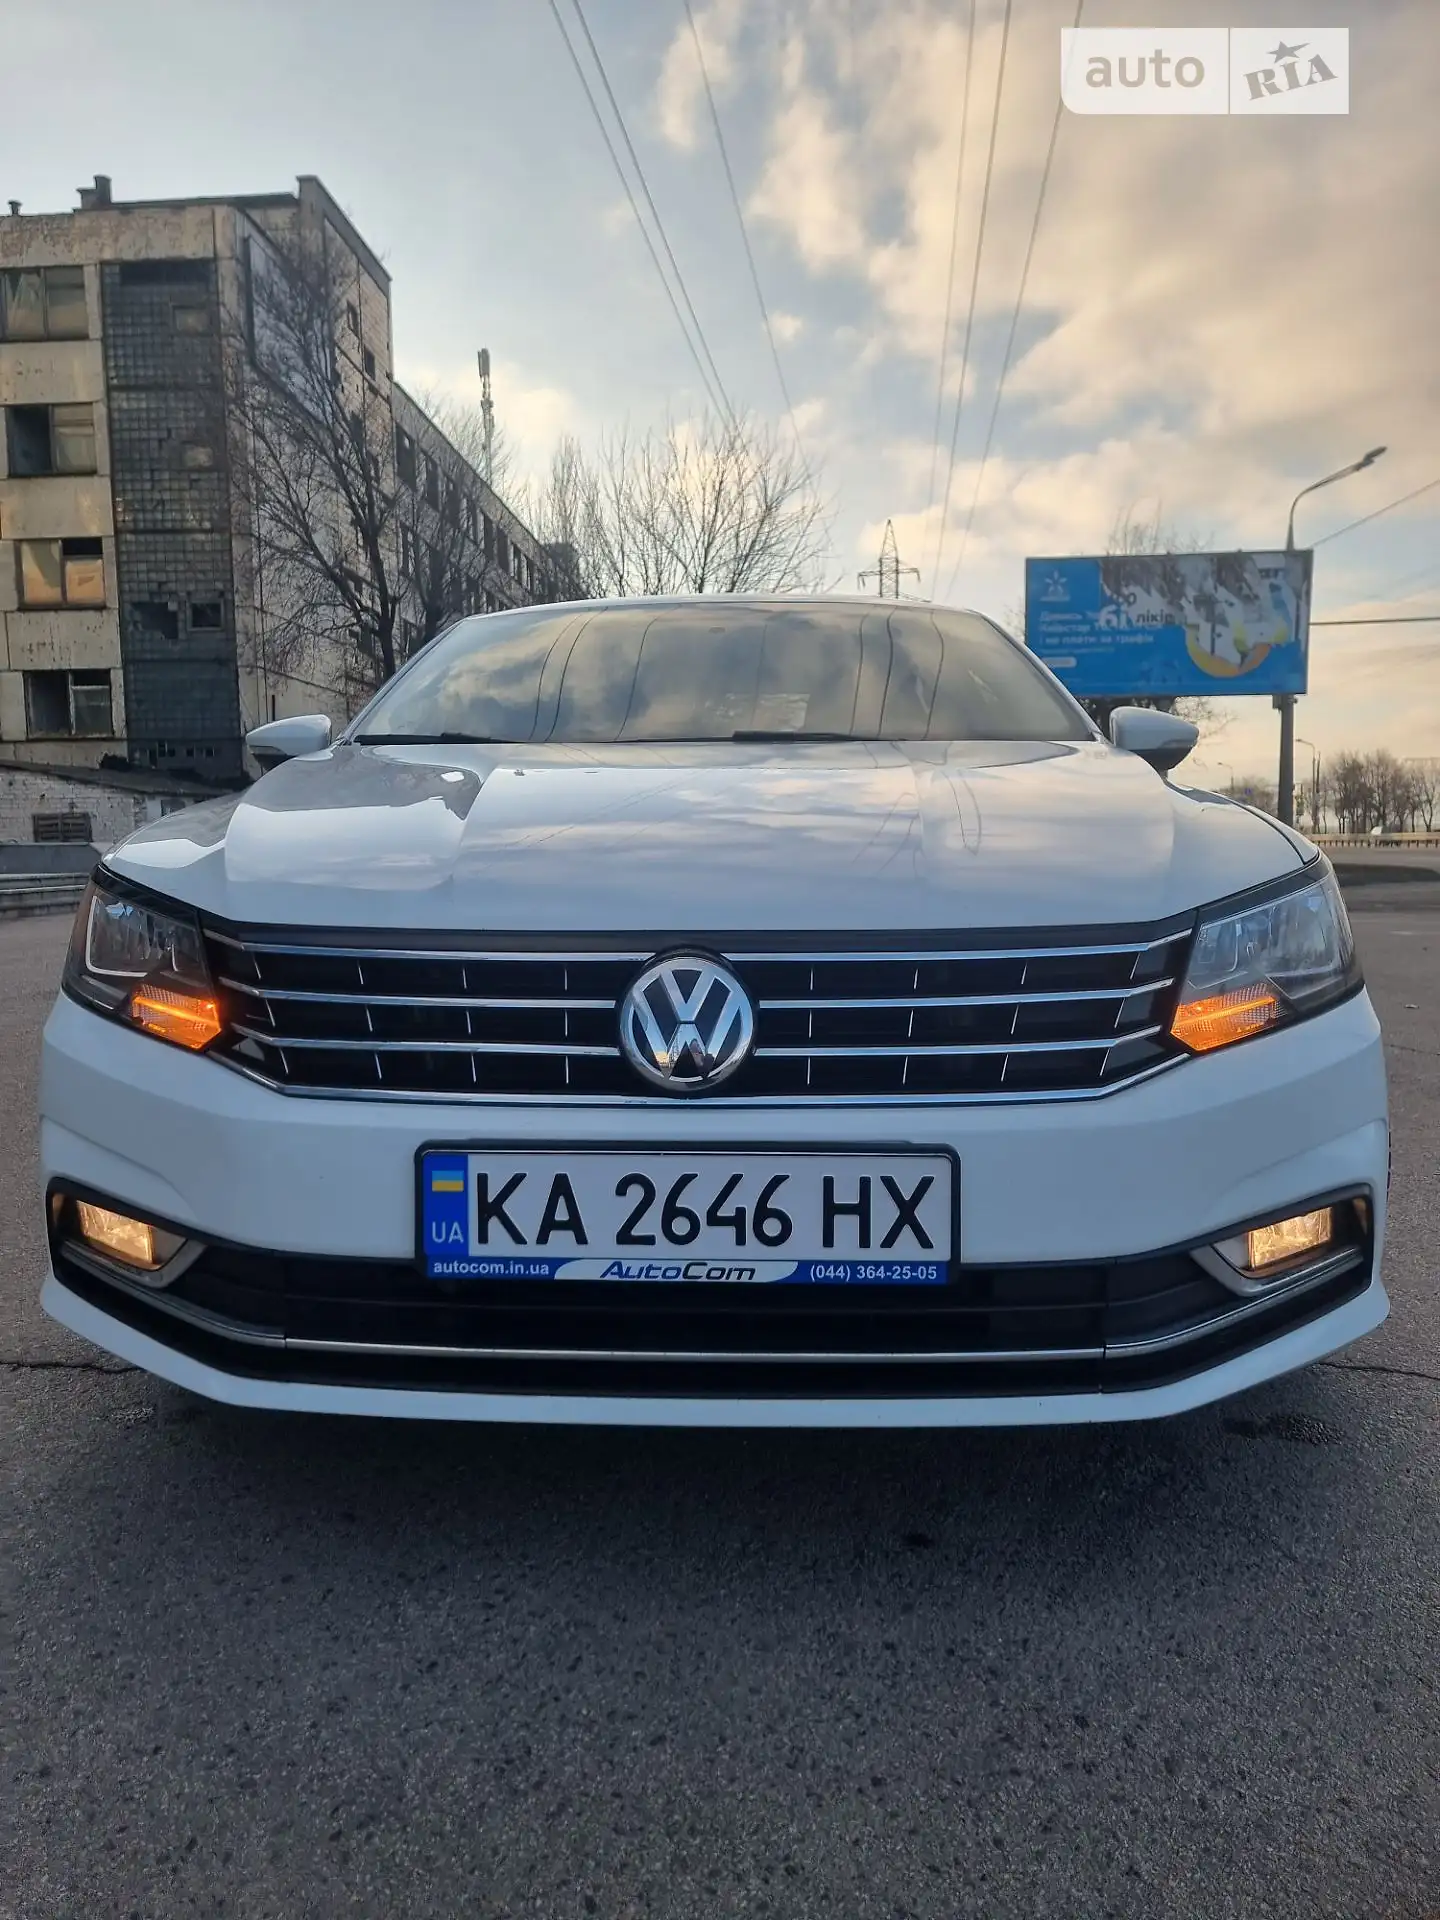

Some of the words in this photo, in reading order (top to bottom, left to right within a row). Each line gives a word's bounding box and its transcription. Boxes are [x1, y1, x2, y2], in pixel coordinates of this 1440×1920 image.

[476, 1172, 589, 1246] KA
[615, 1172, 793, 1247] 2646
[823, 1175, 935, 1249] HX
[431, 1220, 465, 1244] UA
[433, 1260, 549, 1276] autocom.in.ua
[600, 1260, 756, 1281] AutoCom
[810, 1264, 851, 1282] (044)
[856, 1264, 938, 1280] 364-25-05
